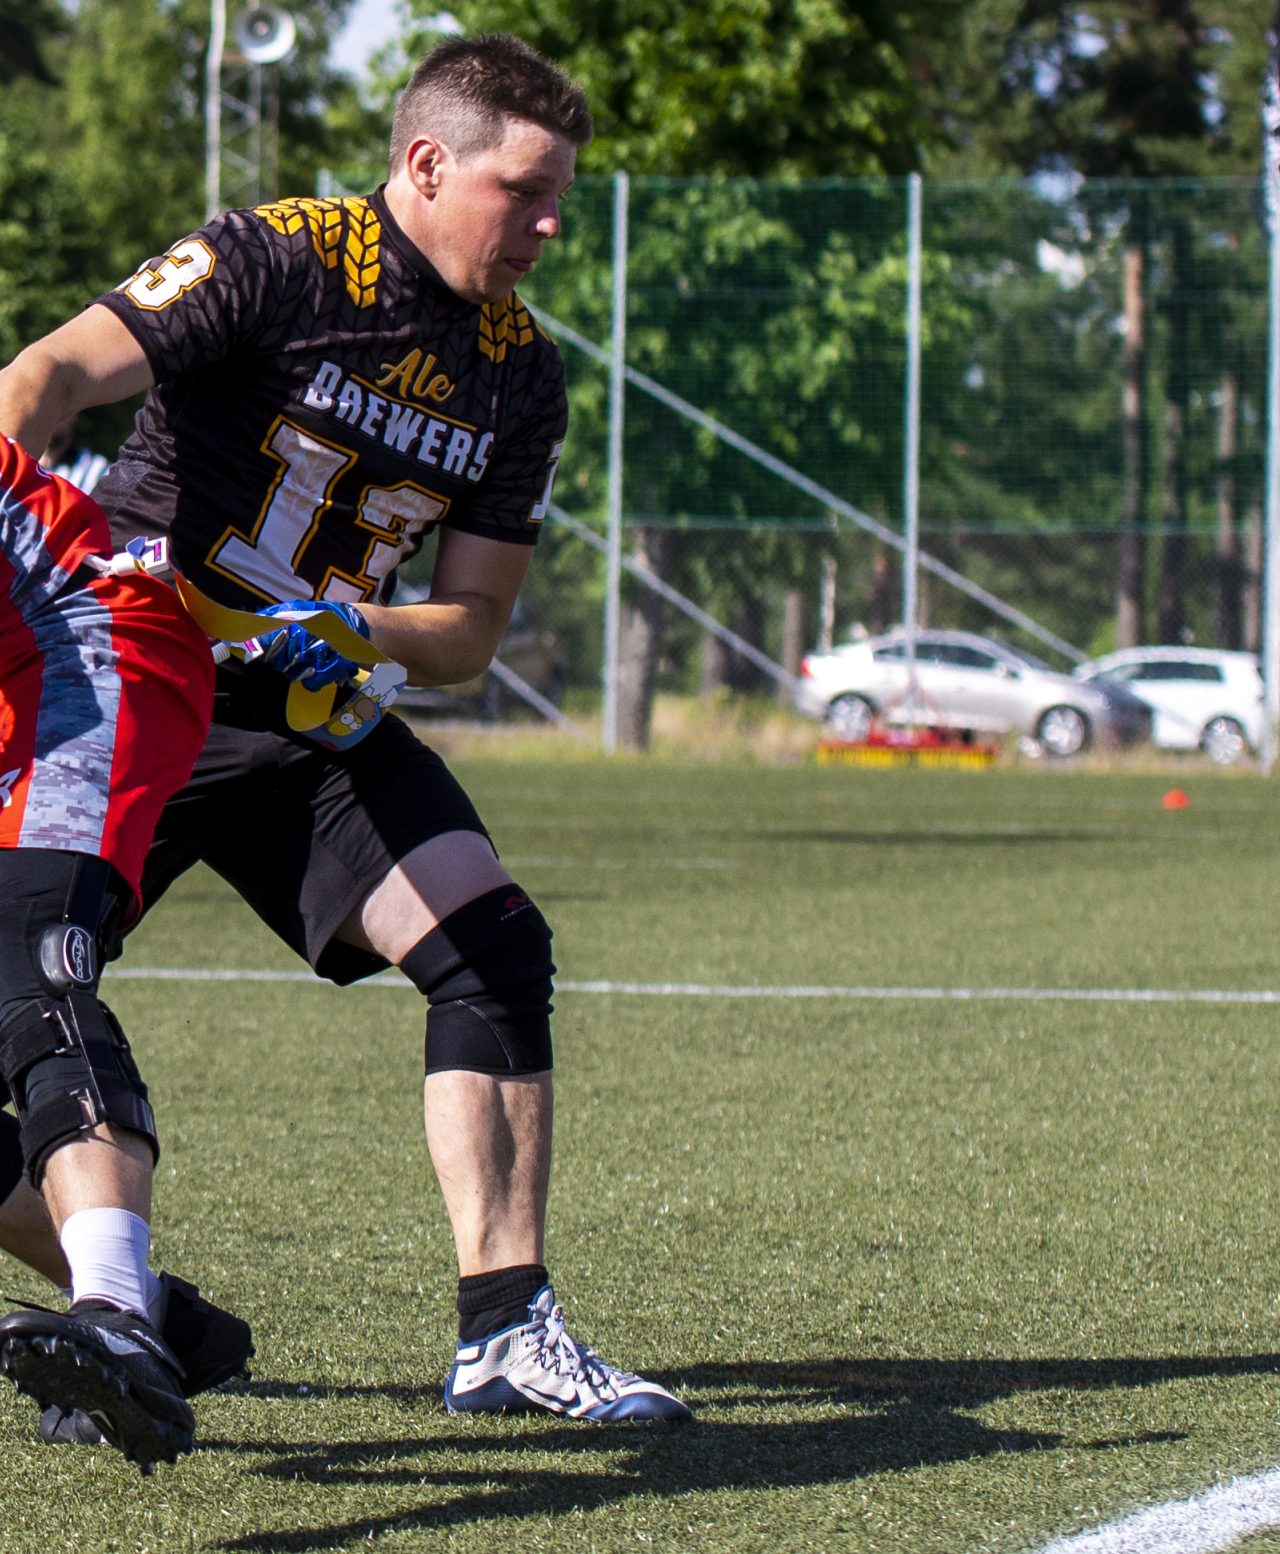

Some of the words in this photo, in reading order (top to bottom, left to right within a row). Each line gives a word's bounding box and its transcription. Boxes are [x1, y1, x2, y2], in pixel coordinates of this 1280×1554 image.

[111, 238, 216, 312] 3
[303, 360, 495, 482] BREWERS
[375, 347, 456, 403] Ale
[204, 414, 451, 604] 13
